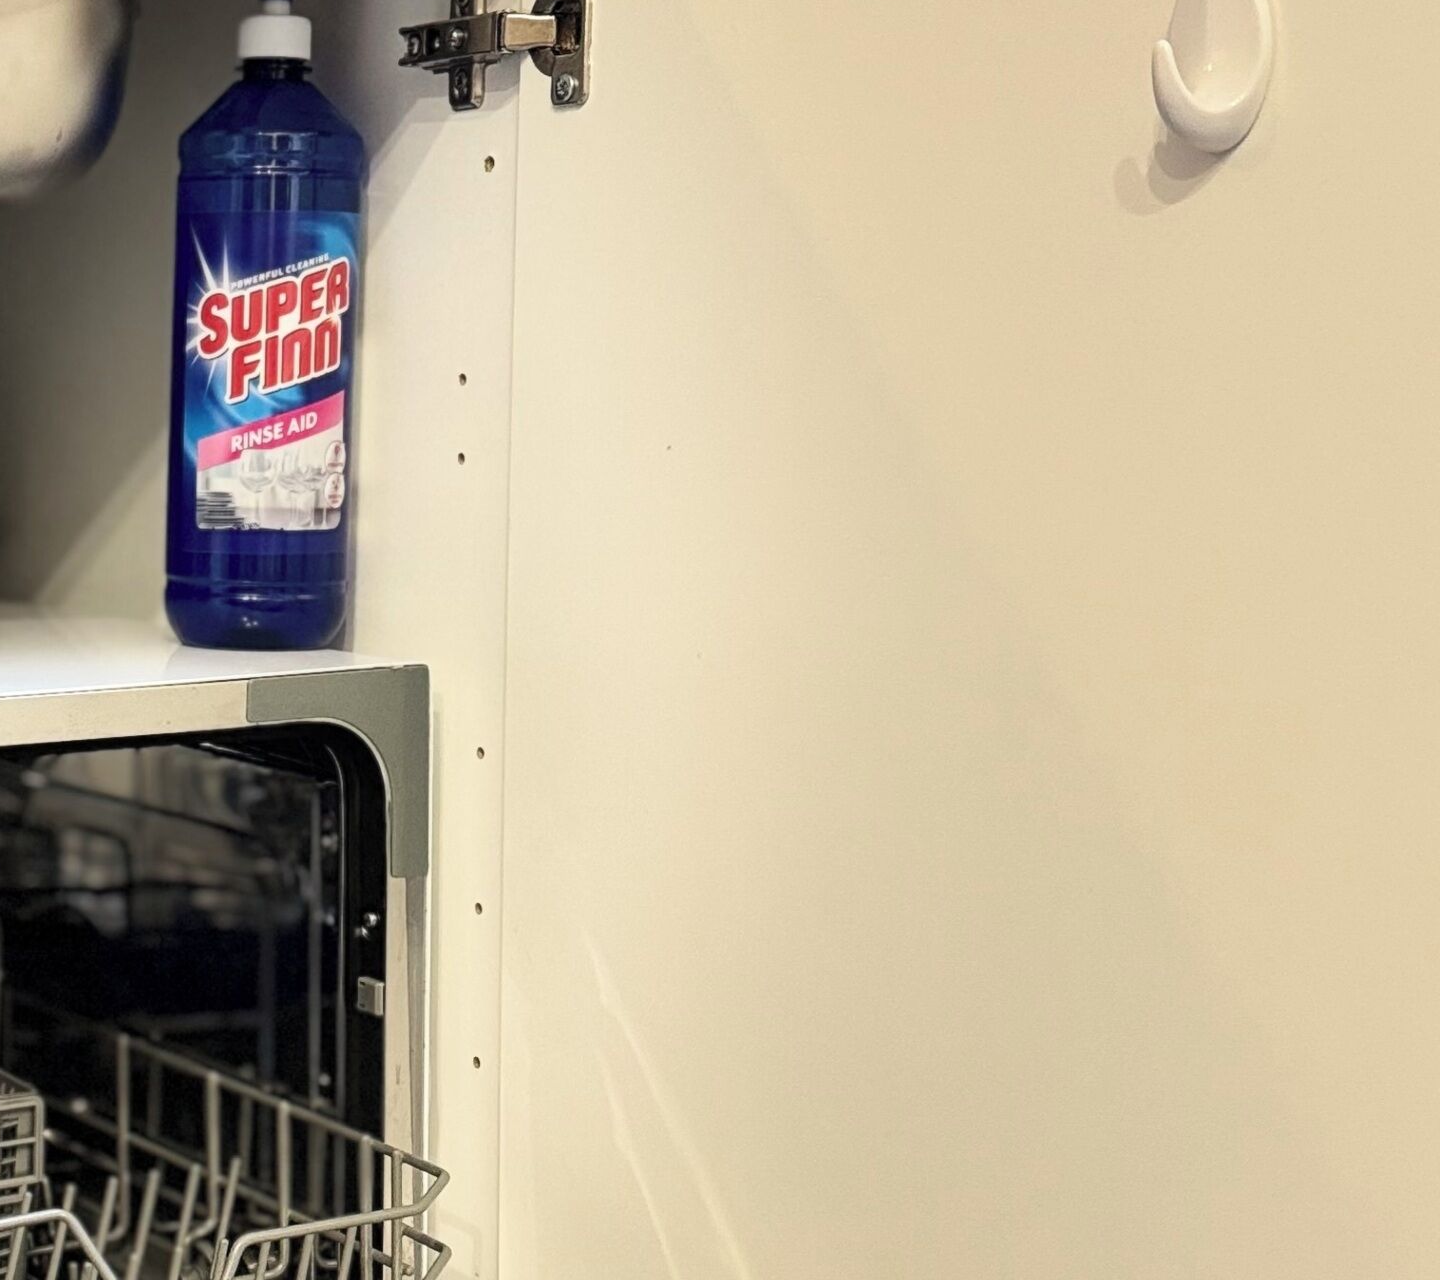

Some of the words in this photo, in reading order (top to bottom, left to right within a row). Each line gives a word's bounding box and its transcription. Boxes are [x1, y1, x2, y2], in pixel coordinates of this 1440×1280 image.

[231, 268, 284, 290] POWERFUL
[285, 252, 329, 272] CLEANING
[199, 260, 349, 356] SUPER
[228, 317, 339, 400] FINN
[230, 423, 284, 453] RINSE
[287, 412, 318, 436] AID
